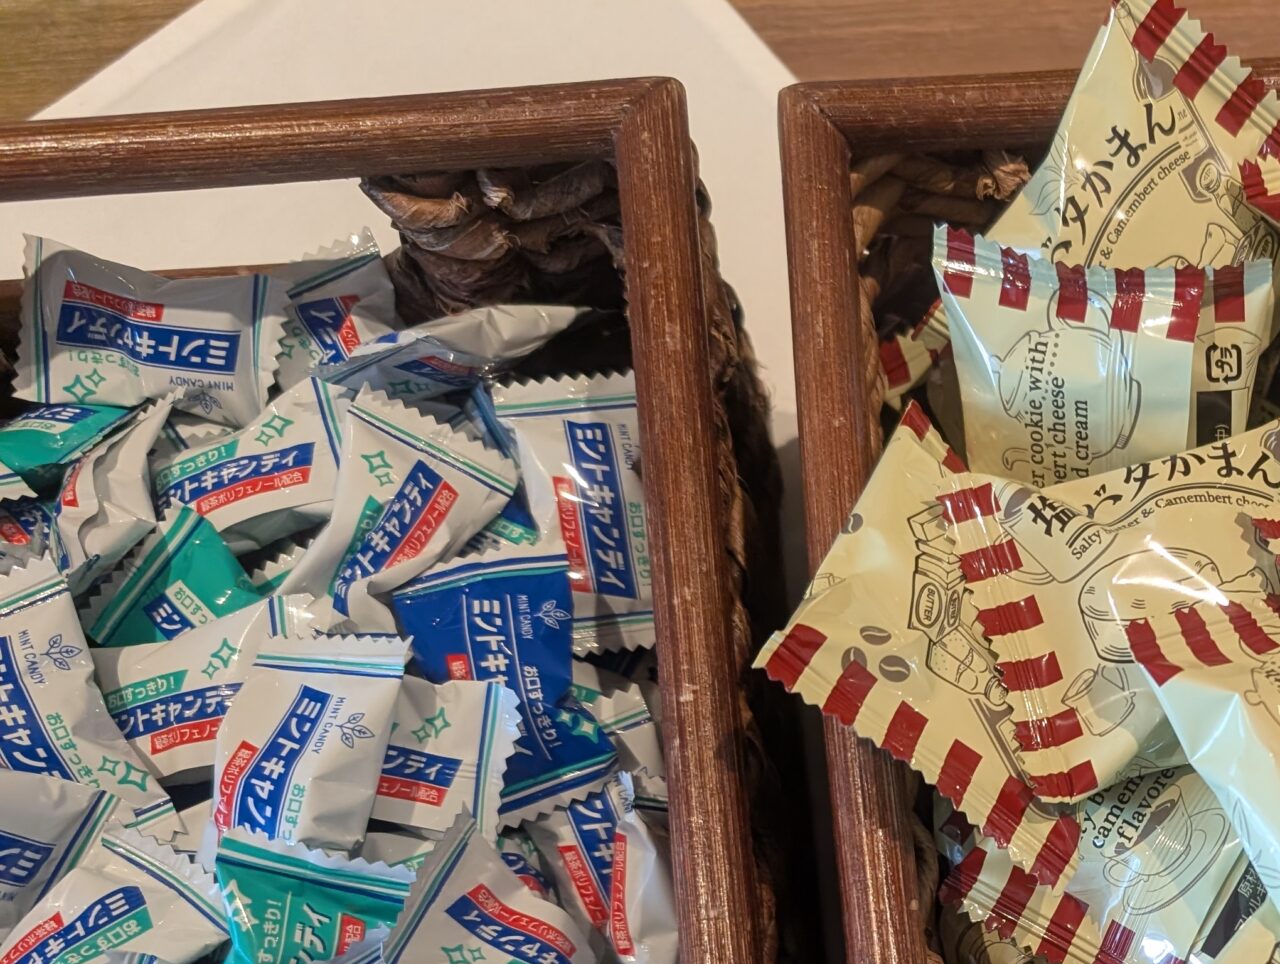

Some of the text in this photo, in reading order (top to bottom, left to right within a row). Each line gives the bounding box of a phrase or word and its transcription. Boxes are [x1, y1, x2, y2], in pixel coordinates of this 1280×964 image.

[1157, 149, 1192, 181] cheese
[1026, 339, 1049, 466] with cookie
[1050, 377, 1067, 436] cheese
[1075, 399, 1090, 462] cream
[574, 426, 627, 593] ミントキャンディ
[1070, 529, 1103, 562] Salty
[1154, 491, 1234, 509] Camembert
[516, 594, 534, 641] MINT CANDY
[923, 588, 936, 622] BUTTER
[18, 629, 47, 685] MINT CANDY
[311, 696, 348, 756] MINT CANDY
[521, 665, 564, 750] お口すっきり!
